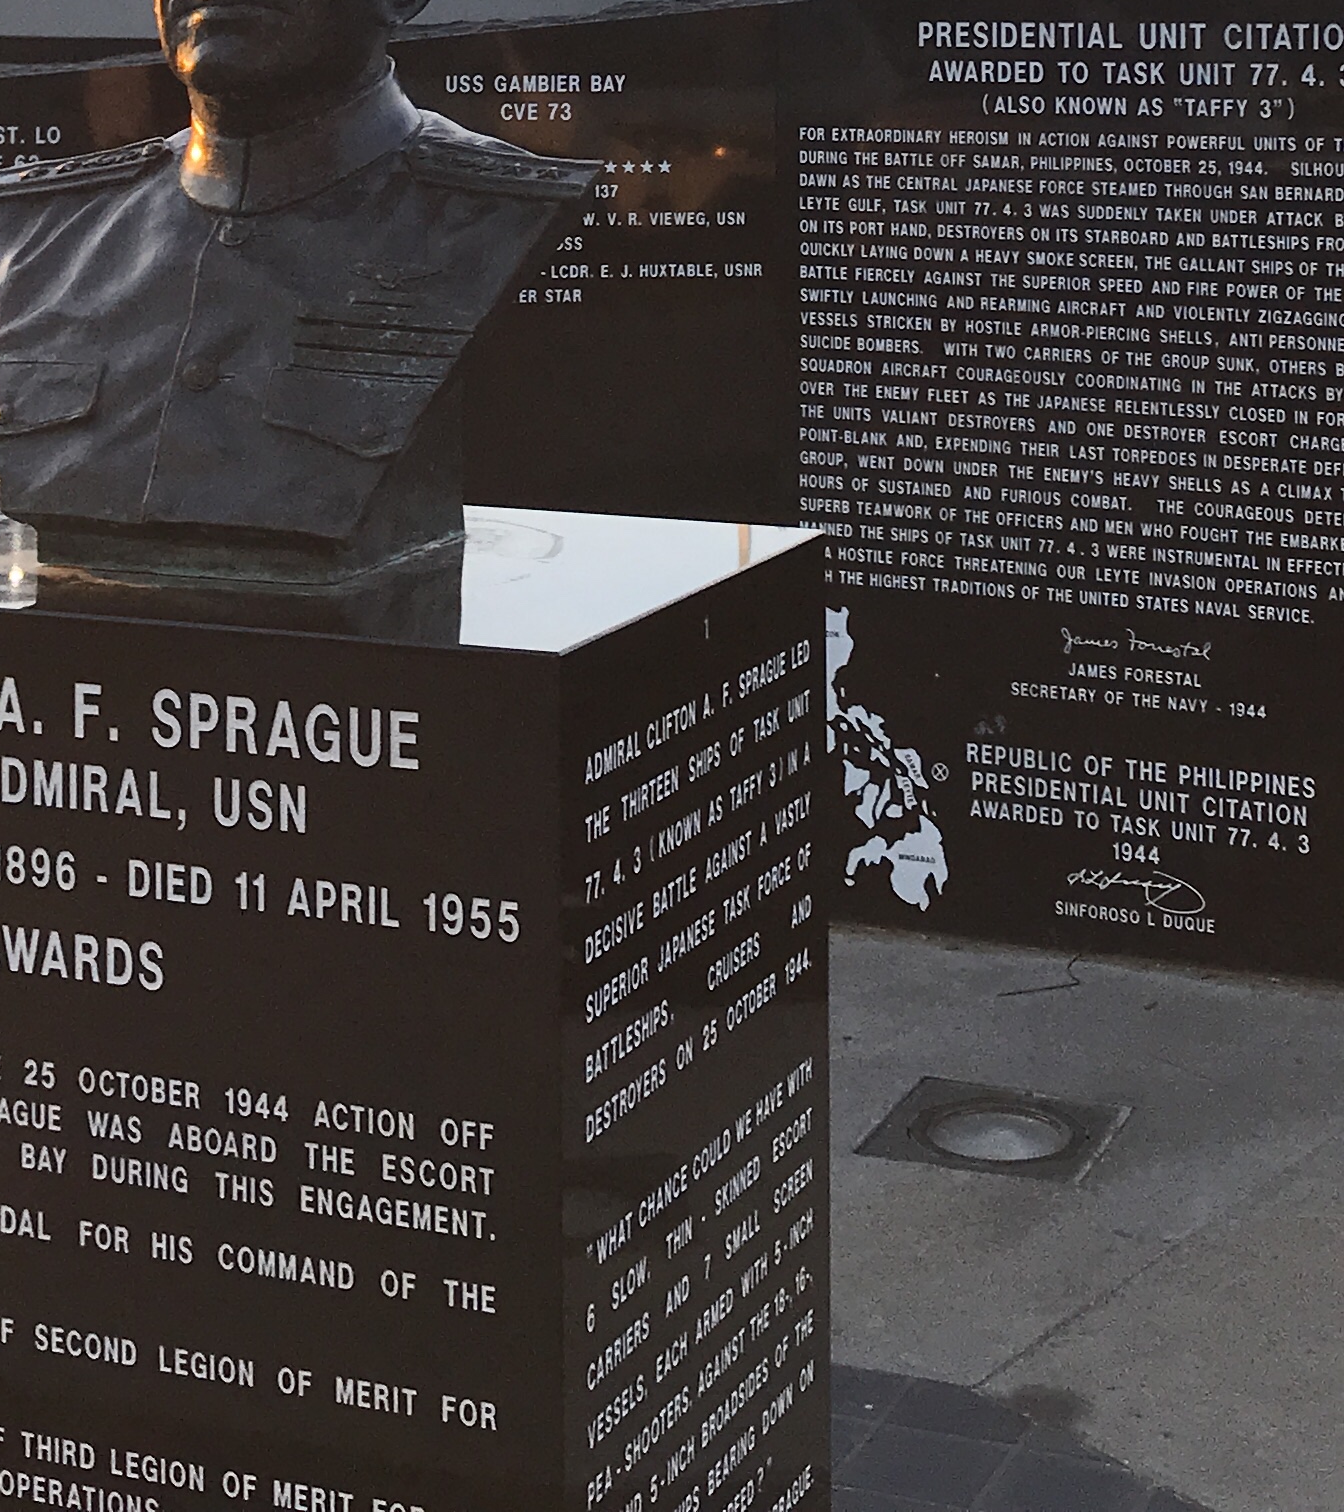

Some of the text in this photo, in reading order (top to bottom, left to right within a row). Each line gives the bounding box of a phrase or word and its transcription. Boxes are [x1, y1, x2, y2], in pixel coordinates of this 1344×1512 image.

[918, 21, 1123, 49] PRESIDENTIAL
[1139, 22, 1207, 50] UNIT
[445, 74, 626, 93] USS GAMBIER BAY
[928, 60, 1044, 83] AWARDED
[1057, 61, 1089, 84] TO
[1102, 61, 1165, 85] TASK
[1179, 62, 1236, 86] UNIT
[1250, 63, 1287, 86] 77.
[1300, 64, 1325, 87] 4.
[500, 102, 572, 121] CVE 73
[1055, 96, 1127, 116] KNOWN
[1137, 97, 1163, 117] AS
[35, 126, 61, 145] LO
[799, 127, 825, 141] FOR
[831, 127, 942, 144] EXTRAORDINARY
[949, 130, 1009, 146] HEROISM
[1018, 132, 1032, 146] IN
[1038, 132, 1090, 147] ACTION
[1097, 133, 1159, 149] AGAINST
[1167, 134, 1246, 151] POWERFUL
[1253, 136, 1297, 152] UNITS
[1304, 137, 1325, 152] OF
[595, 184, 619, 199] 137
[607, 212, 622, 226] V.
[628, 212, 642, 226] R.
[649, 211, 710, 227] VIEWEG,
[716, 211, 745, 226] USN
[551, 263, 763, 279] LCDR. E. J. HUXTABLE, USNR
[1068, 662, 1202, 688] JAMES FORESTAL
[585, 639, 810, 785] ADMIRAL CLIFTON A. F. SPRAGUE LED
[74, 682, 119, 742] F.
[151, 688, 419, 770] SPRAGUE
[966, 742, 1315, 799] REPUBLIC OF THE PHILIPPINES
[214, 777, 306, 834] USN
[972, 771, 1307, 827] PRESIDENTIAL UNIT CITATION
[970, 799, 1310, 854] AWARDED TO TASK UNIT 77. 4. 3
[1112, 842, 1160, 865] 1944
[128, 859, 213, 905] DIED
[234, 871, 265, 912] 11
[287, 877, 400, 928] APRIL
[423, 892, 520, 943] 1955
[1055, 900, 1215, 934] SINFOROSO L DUQUE
[24, 1058, 55, 1089] 25
[78, 1067, 200, 1110] OCTOBER
[224, 1087, 289, 1122] 1944
[314, 1100, 415, 1141] ACTION
[440, 1118, 494, 1150] OFF
